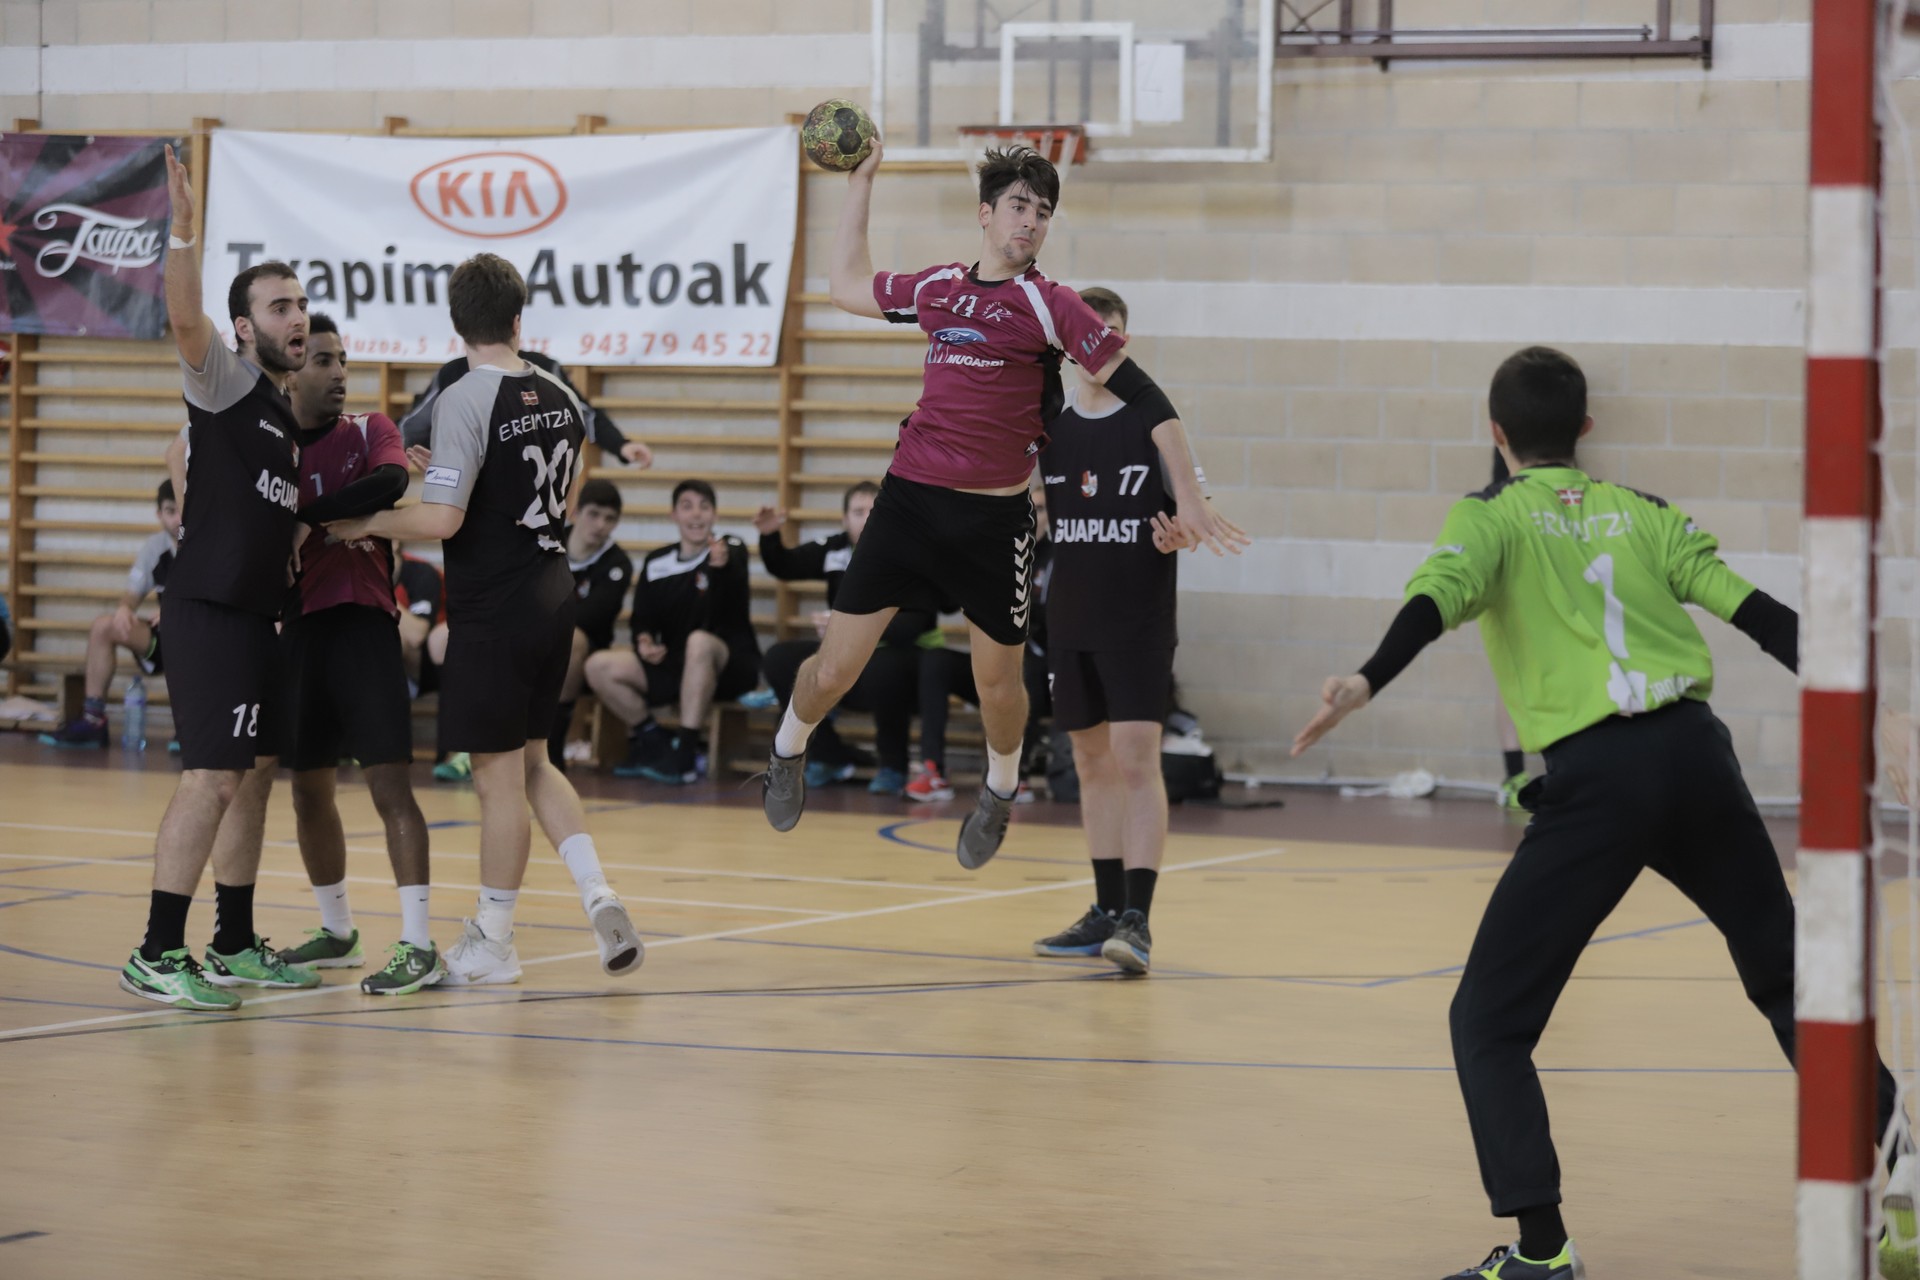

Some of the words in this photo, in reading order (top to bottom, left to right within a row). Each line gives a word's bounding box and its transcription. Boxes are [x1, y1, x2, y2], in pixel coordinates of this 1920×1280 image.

[438, 171, 541, 217] KIA
[525, 243, 772, 306] Autoak
[579, 333, 629, 355] 943
[641, 333, 679, 355] 79
[691, 333, 728, 355] 45
[739, 333, 772, 355] 22
[1119, 465, 1149, 496] 17
[1583, 553, 1630, 659] 1
[232, 703, 260, 737] 18
